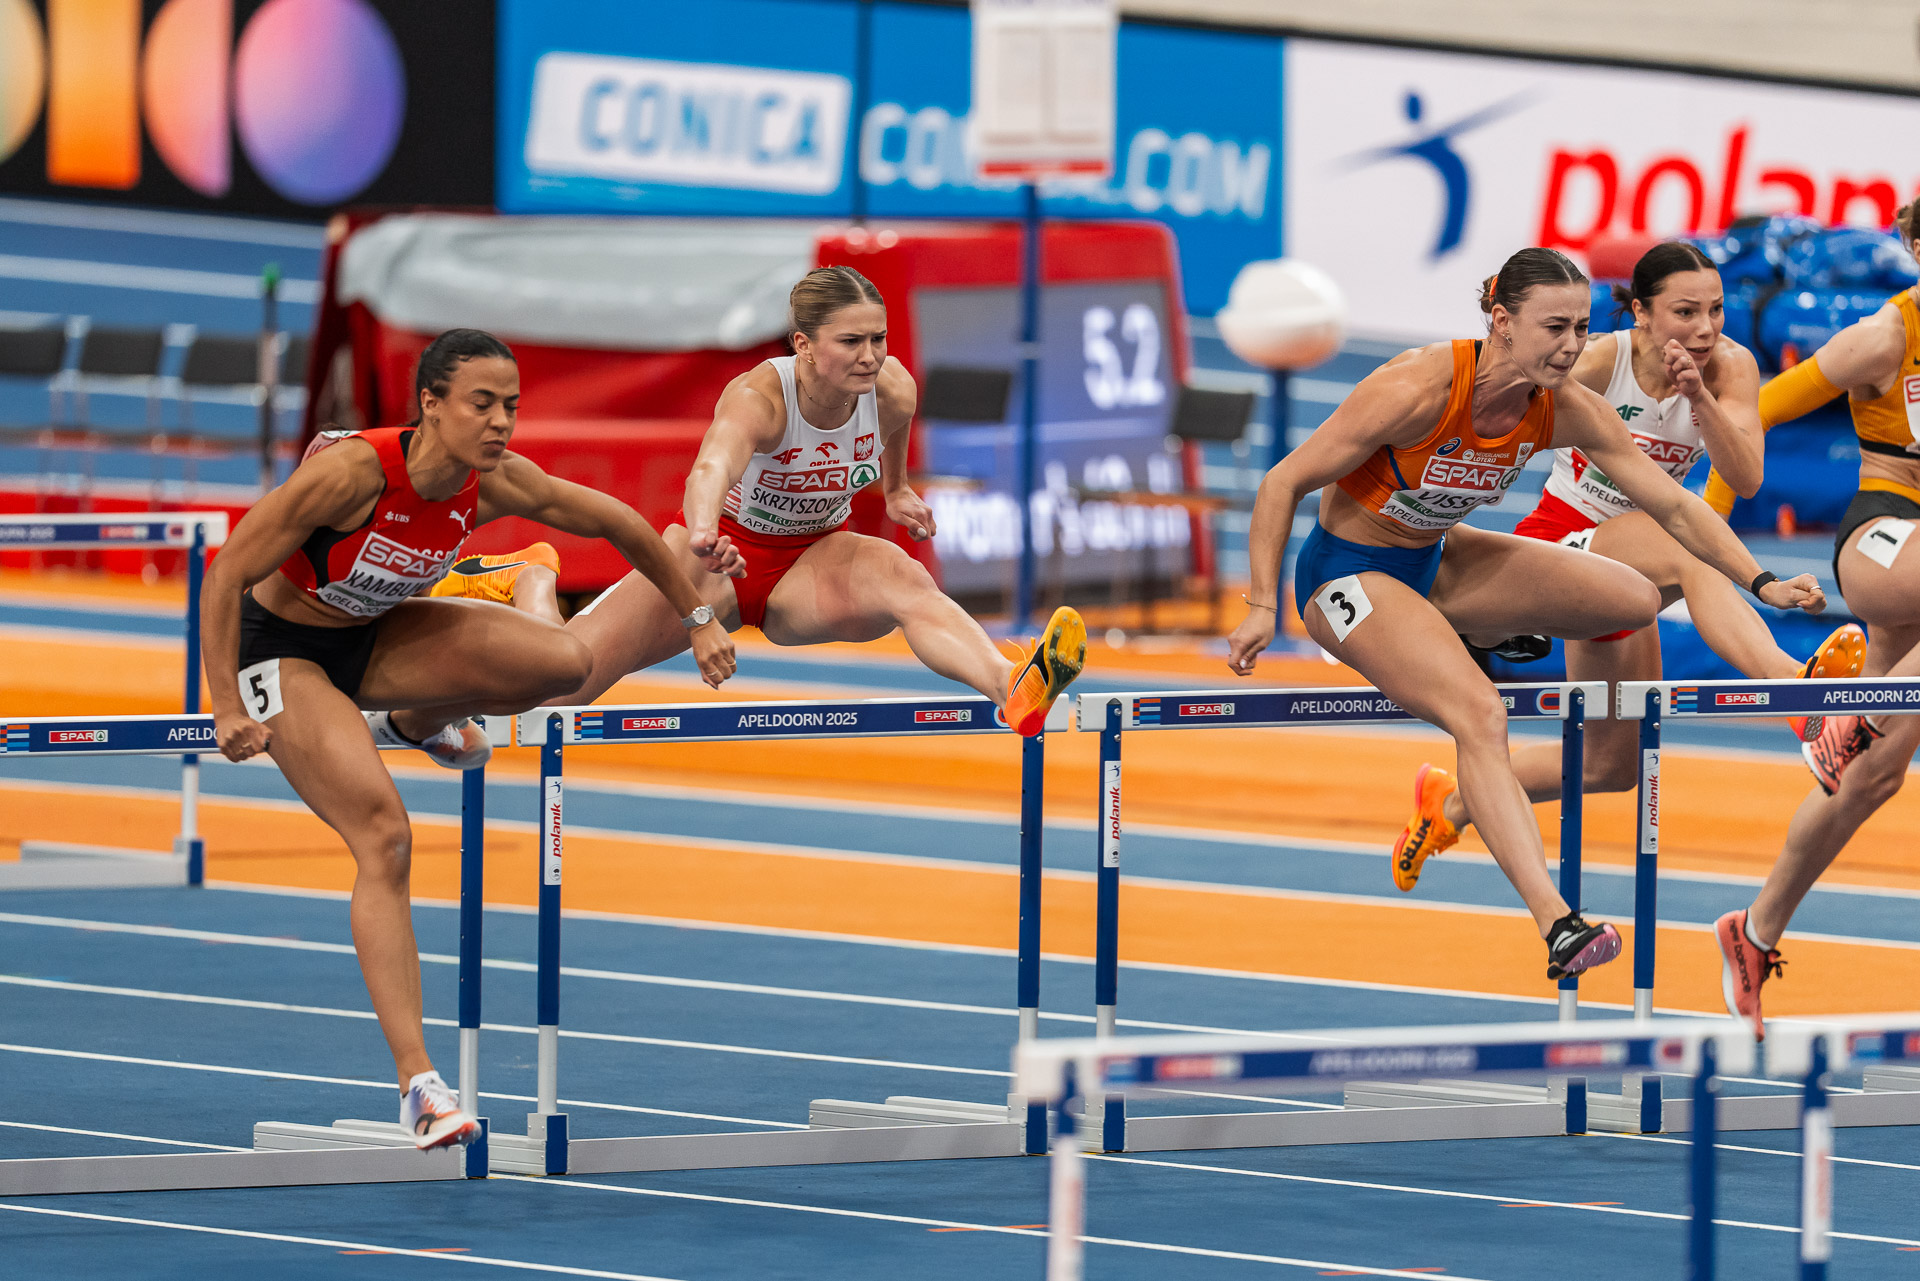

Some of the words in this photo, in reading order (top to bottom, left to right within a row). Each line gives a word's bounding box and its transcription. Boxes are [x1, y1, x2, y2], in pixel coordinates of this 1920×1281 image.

[578, 76, 826, 168] CONICA
[1536, 122, 1920, 250] polan
[1633, 437, 1689, 461] PAR
[761, 470, 846, 491] SPAR
[1428, 463, 1500, 487] SPAR
[1581, 482, 1639, 509] APELDOO
[394, 513, 410, 523] UBS
[743, 517, 826, 535] APELDOORN
[774, 516, 799, 526] RUN
[1870, 530, 1897, 545] 1
[1330, 591, 1356, 626] 3
[249, 673, 269, 714] 5
[1725, 695, 1756, 704] SPAR
[1823, 690, 1903, 704] APELDOORN
[1905, 690, 1920, 702] 20
[1189, 706, 1222, 714] SPAR
[1290, 700, 1373, 714] APELDOORN
[1375, 699, 1404, 712] 202
[633, 720, 666, 728] SPAR
[737, 713, 824, 728] APELDOORN
[826, 712, 858, 726] 2025
[924, 711, 958, 721] SPAR
[60, 732, 94, 741] SPAR
[167, 727, 218, 741] APELD
[1648, 774, 1659, 827] polanik
[1109, 786, 1120, 840] polanik
[550, 802, 561, 857] polanik
[1399, 815, 1433, 871] NITRO
